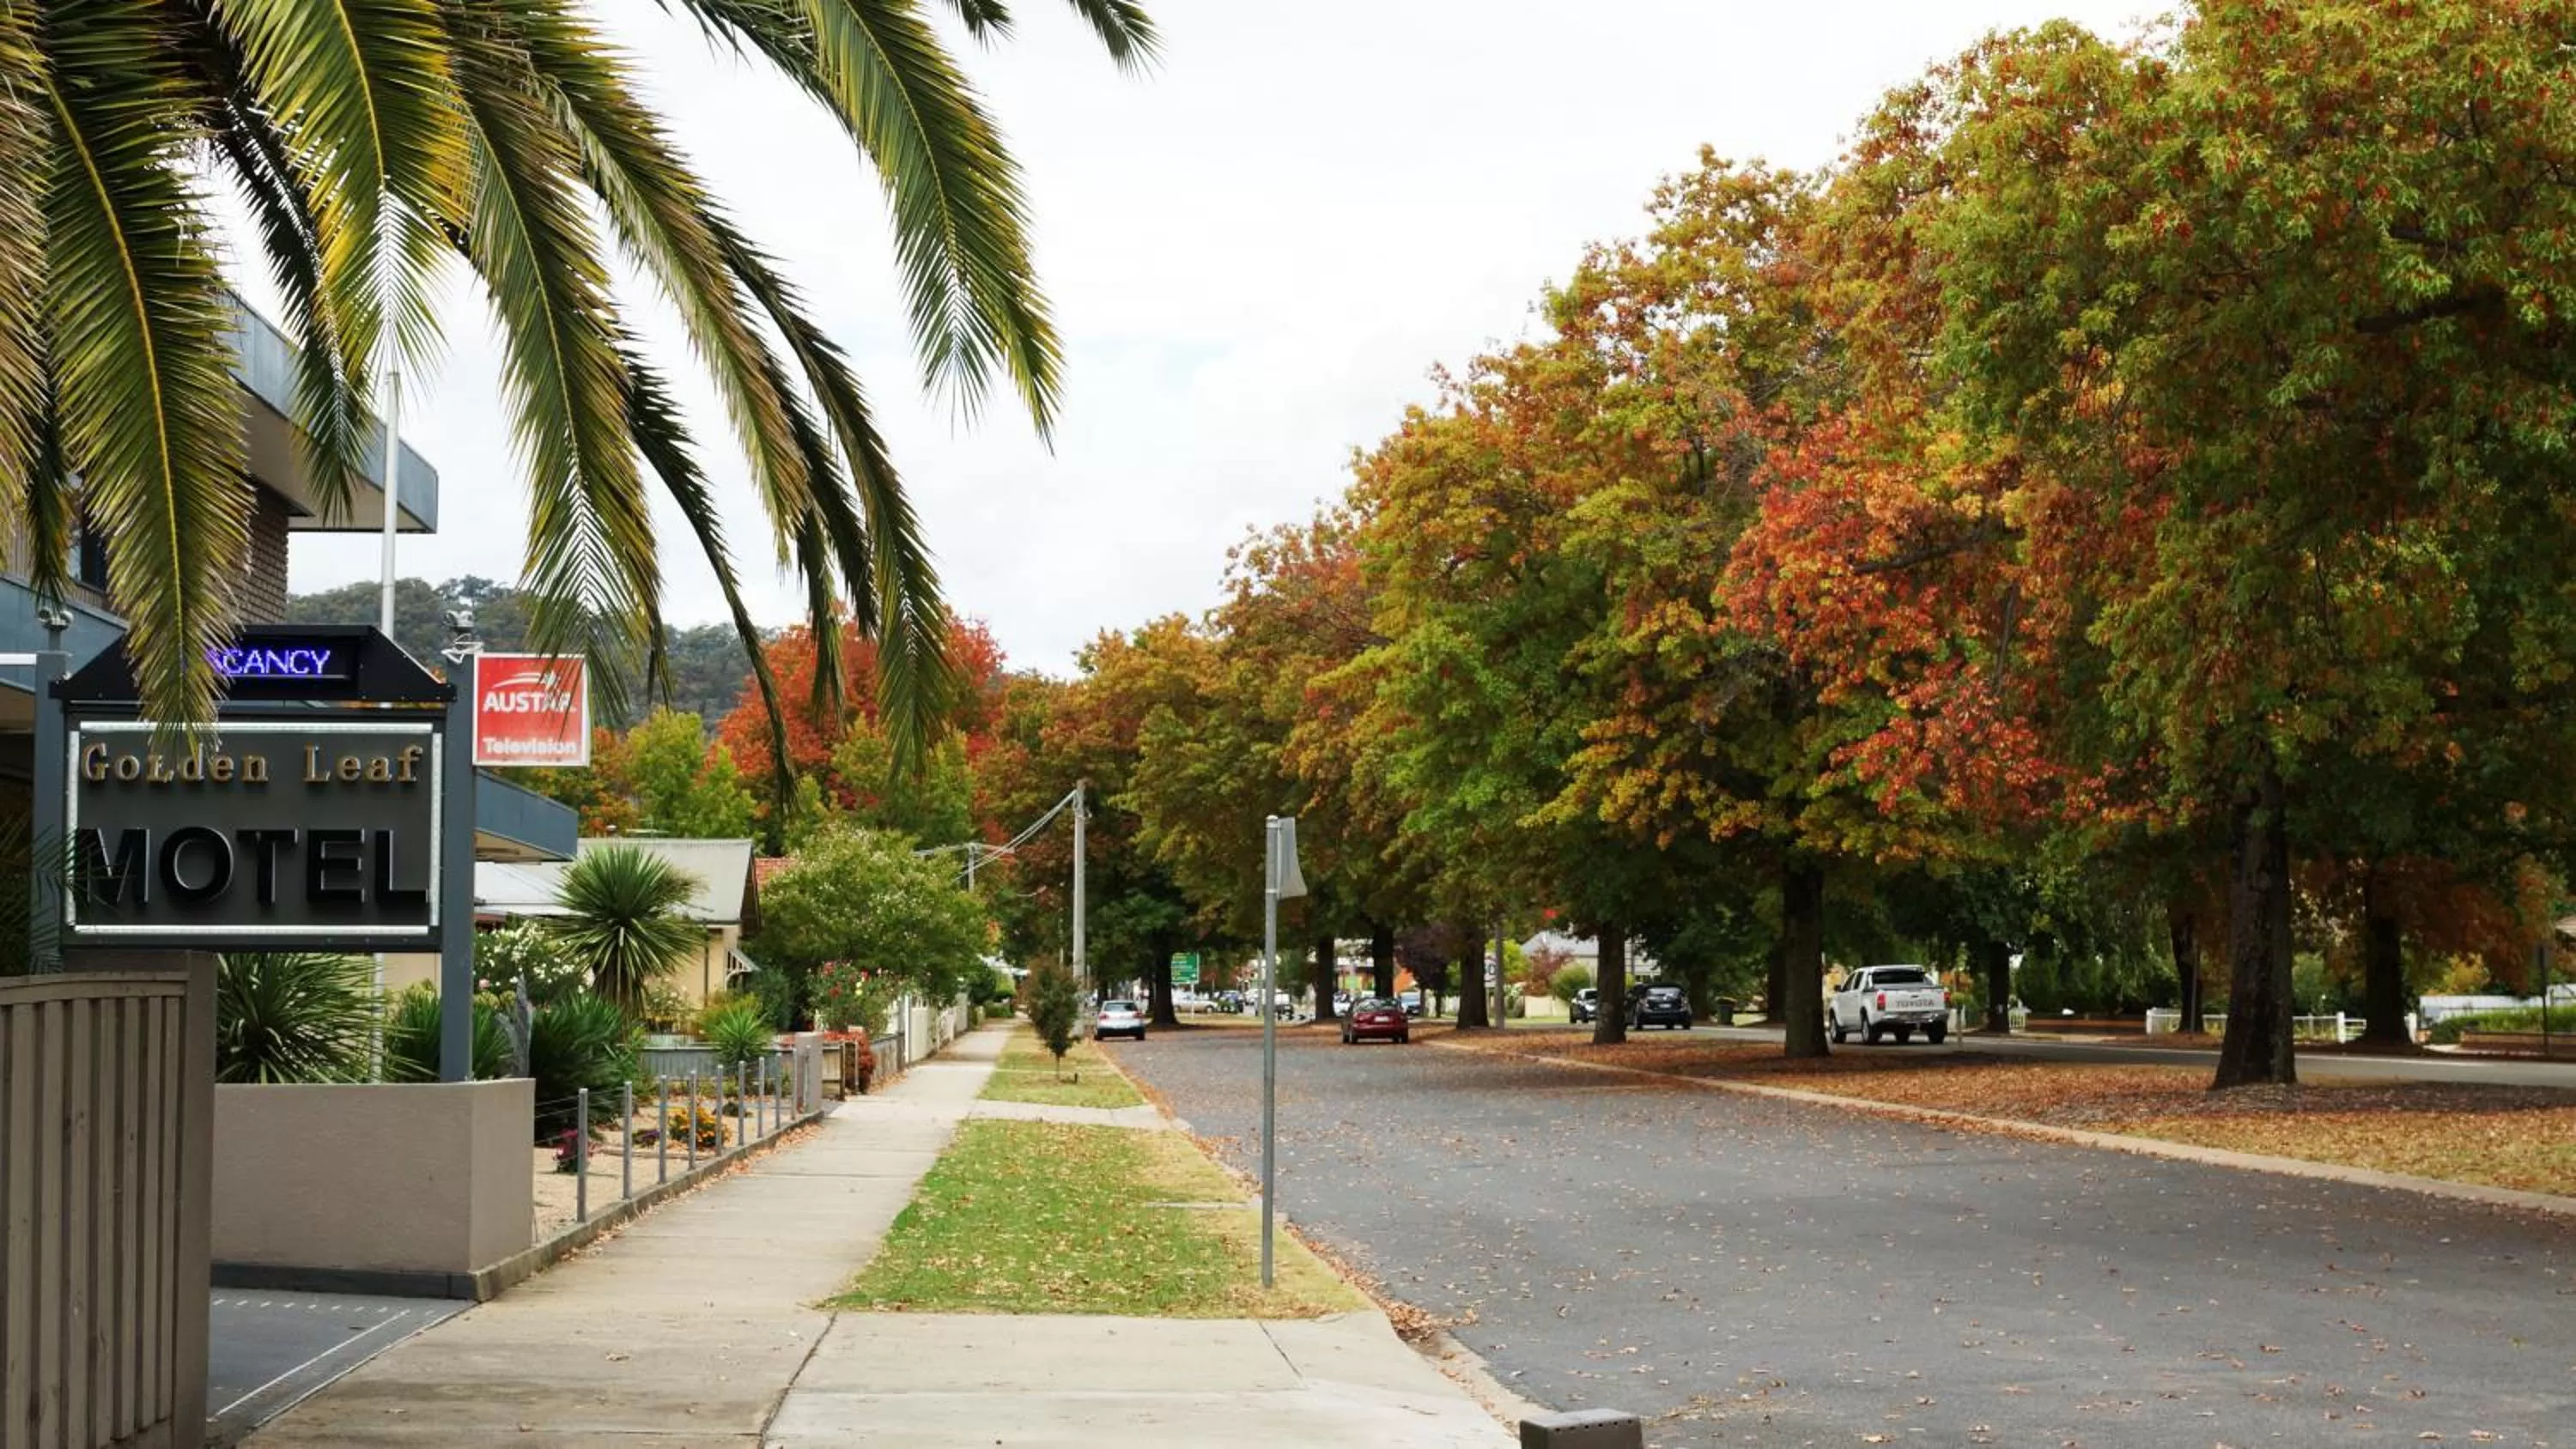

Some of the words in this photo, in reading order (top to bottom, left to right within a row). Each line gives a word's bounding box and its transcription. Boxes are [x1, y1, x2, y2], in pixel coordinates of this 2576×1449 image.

[303, 743, 424, 783] Leaf
[482, 737, 578, 755] Television
[76, 826, 428, 906] MOTEL
